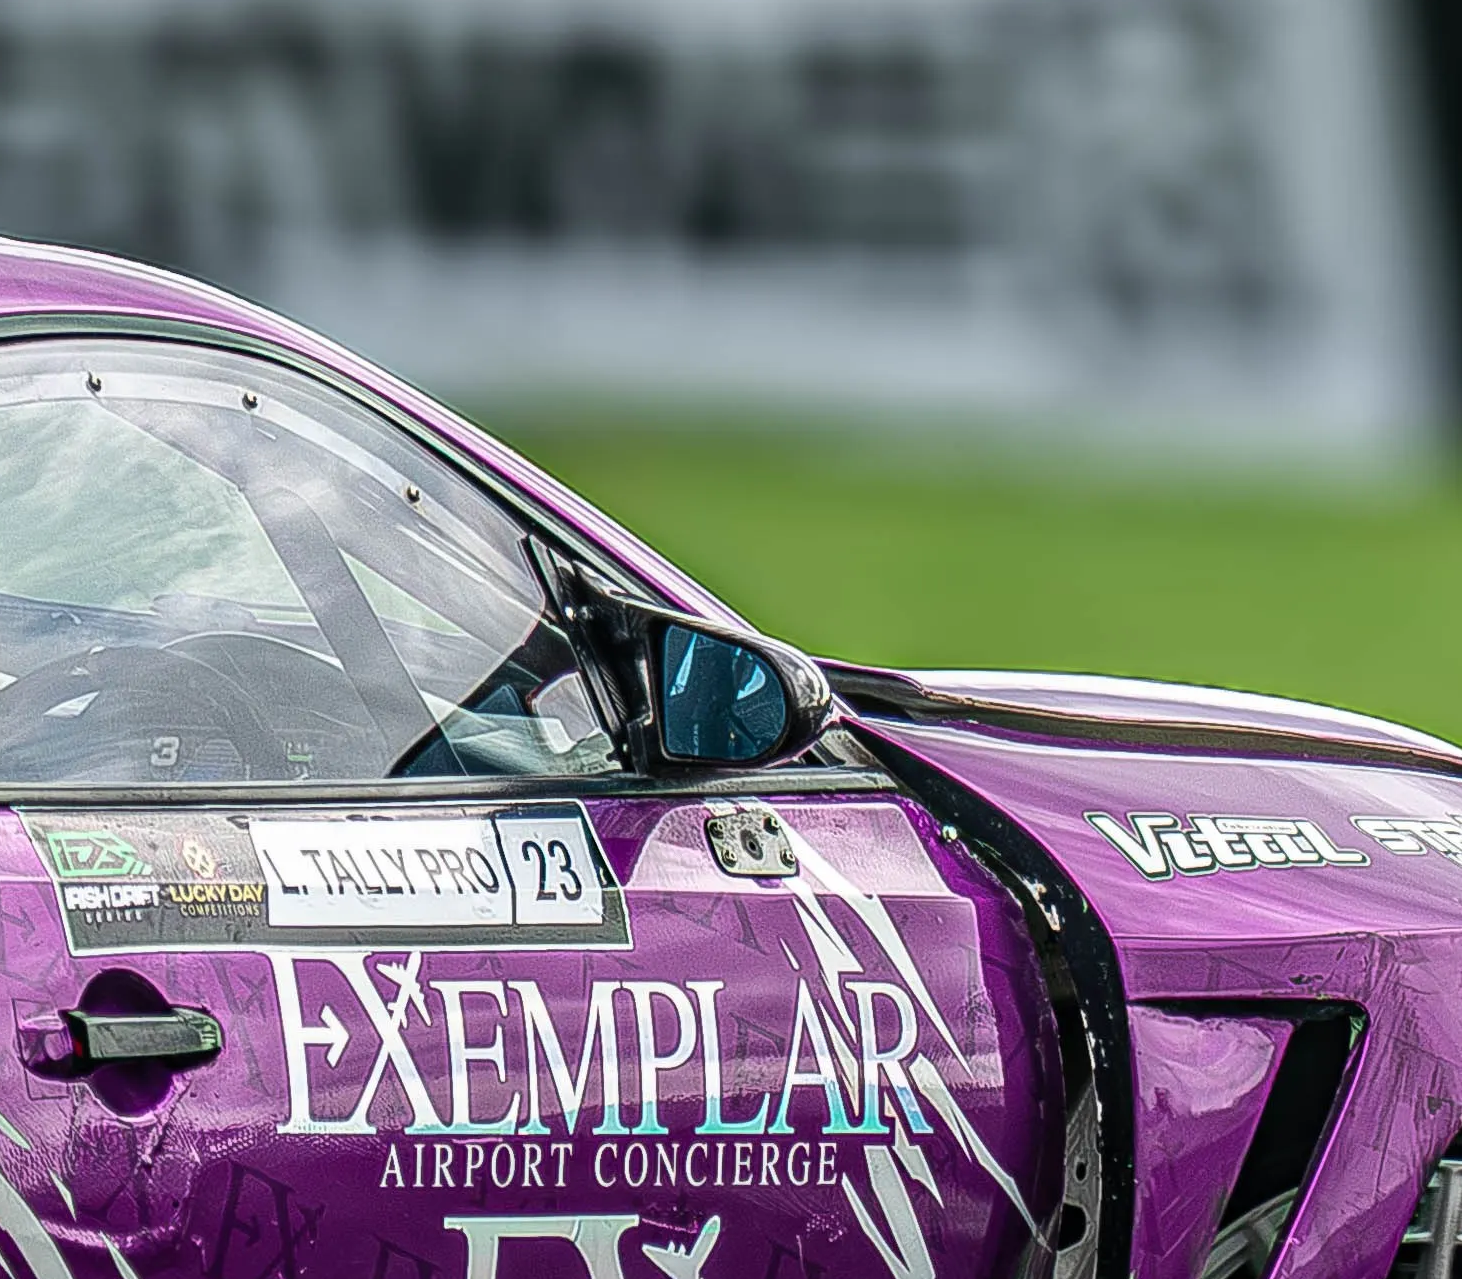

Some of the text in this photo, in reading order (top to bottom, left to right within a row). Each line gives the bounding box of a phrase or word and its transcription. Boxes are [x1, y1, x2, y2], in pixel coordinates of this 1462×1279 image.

[170, 882, 265, 903] LUCKY DAY
[262, 846, 500, 896] L. TALLY PRO
[521, 838, 583, 902] 23
[180, 903, 260, 918] COMPETITIONS
[276, 951, 935, 1136] EXEMPLAR
[379, 1141, 838, 1188] AIRPORT CONCIERGE
